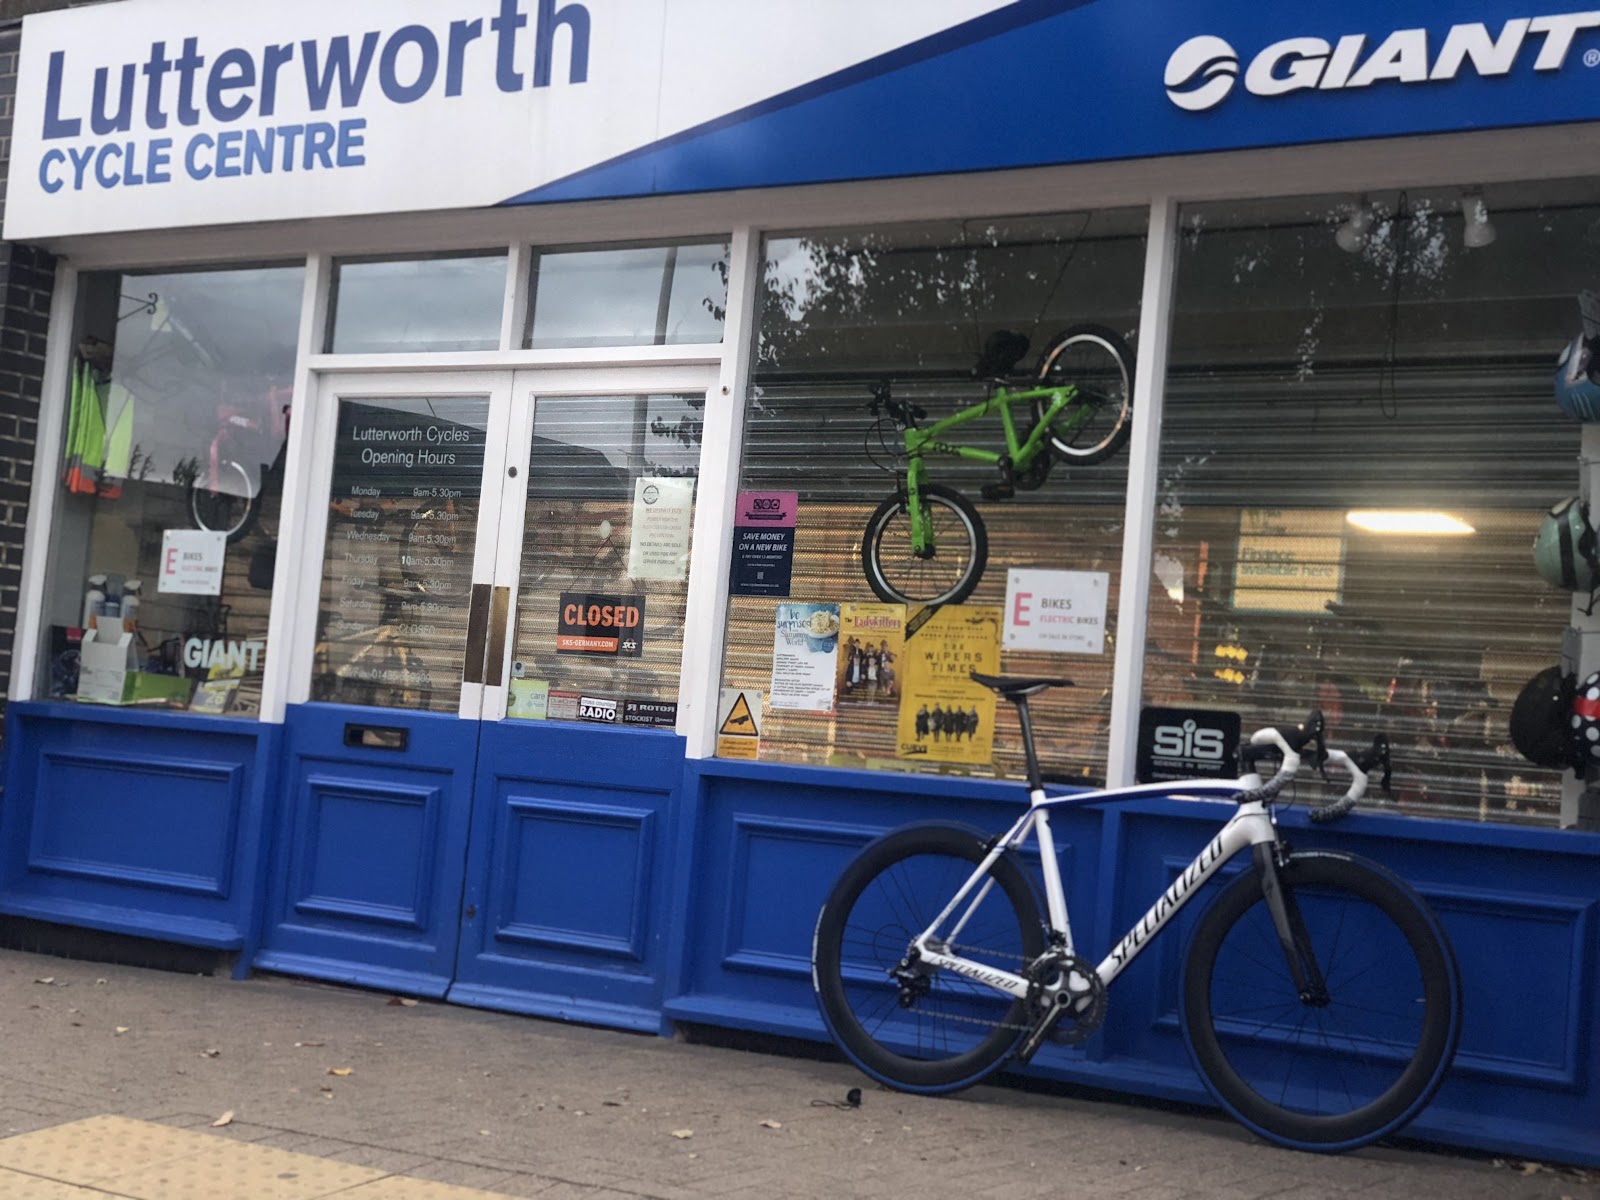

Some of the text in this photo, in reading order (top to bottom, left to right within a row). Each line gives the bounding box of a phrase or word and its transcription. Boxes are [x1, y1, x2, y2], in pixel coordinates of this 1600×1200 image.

[1244, 10, 1600, 96] GIANT
[41, 0, 591, 140] Lutterworth
[38, 117, 367, 194] CYCLE CENTRE
[352, 425, 470, 446] Lutterworth Cycles
[361, 447, 456, 468] Opening Hours
[351, 486, 381, 498] Monday
[351, 509, 380, 520] Tuesday
[347, 530, 391, 543] Wednesday
[743, 532, 785, 541] SAVE MONEY
[738, 543, 750, 551] ON
[750, 543, 755, 551] A
[755, 543, 772, 551] NEW
[166, 548, 178, 575] E
[345, 552, 378, 566] Thursday
[1302, 563, 1334, 577] here
[341, 576, 366, 588] Friday
[339, 598, 372, 610] Saturday
[1013, 592, 1072, 626] E BIKES
[564, 603, 640, 628] CLOSED
[1039, 614, 1099, 625] ELECTRIC BIKES
[562, 639, 614, 648] SKS-GERMANY.COM
[183, 637, 265, 672] GIANT
[925, 652, 983, 662] WIPERS
[931, 662, 977, 673] TIMES
[530, 691, 546, 700] care
[582, 698, 616, 708] cross counties
[579, 705, 616, 721] RADIO
[625, 715, 653, 723] STOCKIST
[1111, 836, 1224, 966] SPECIALIZED
[936, 956, 1020, 990] SPECIALIZED
